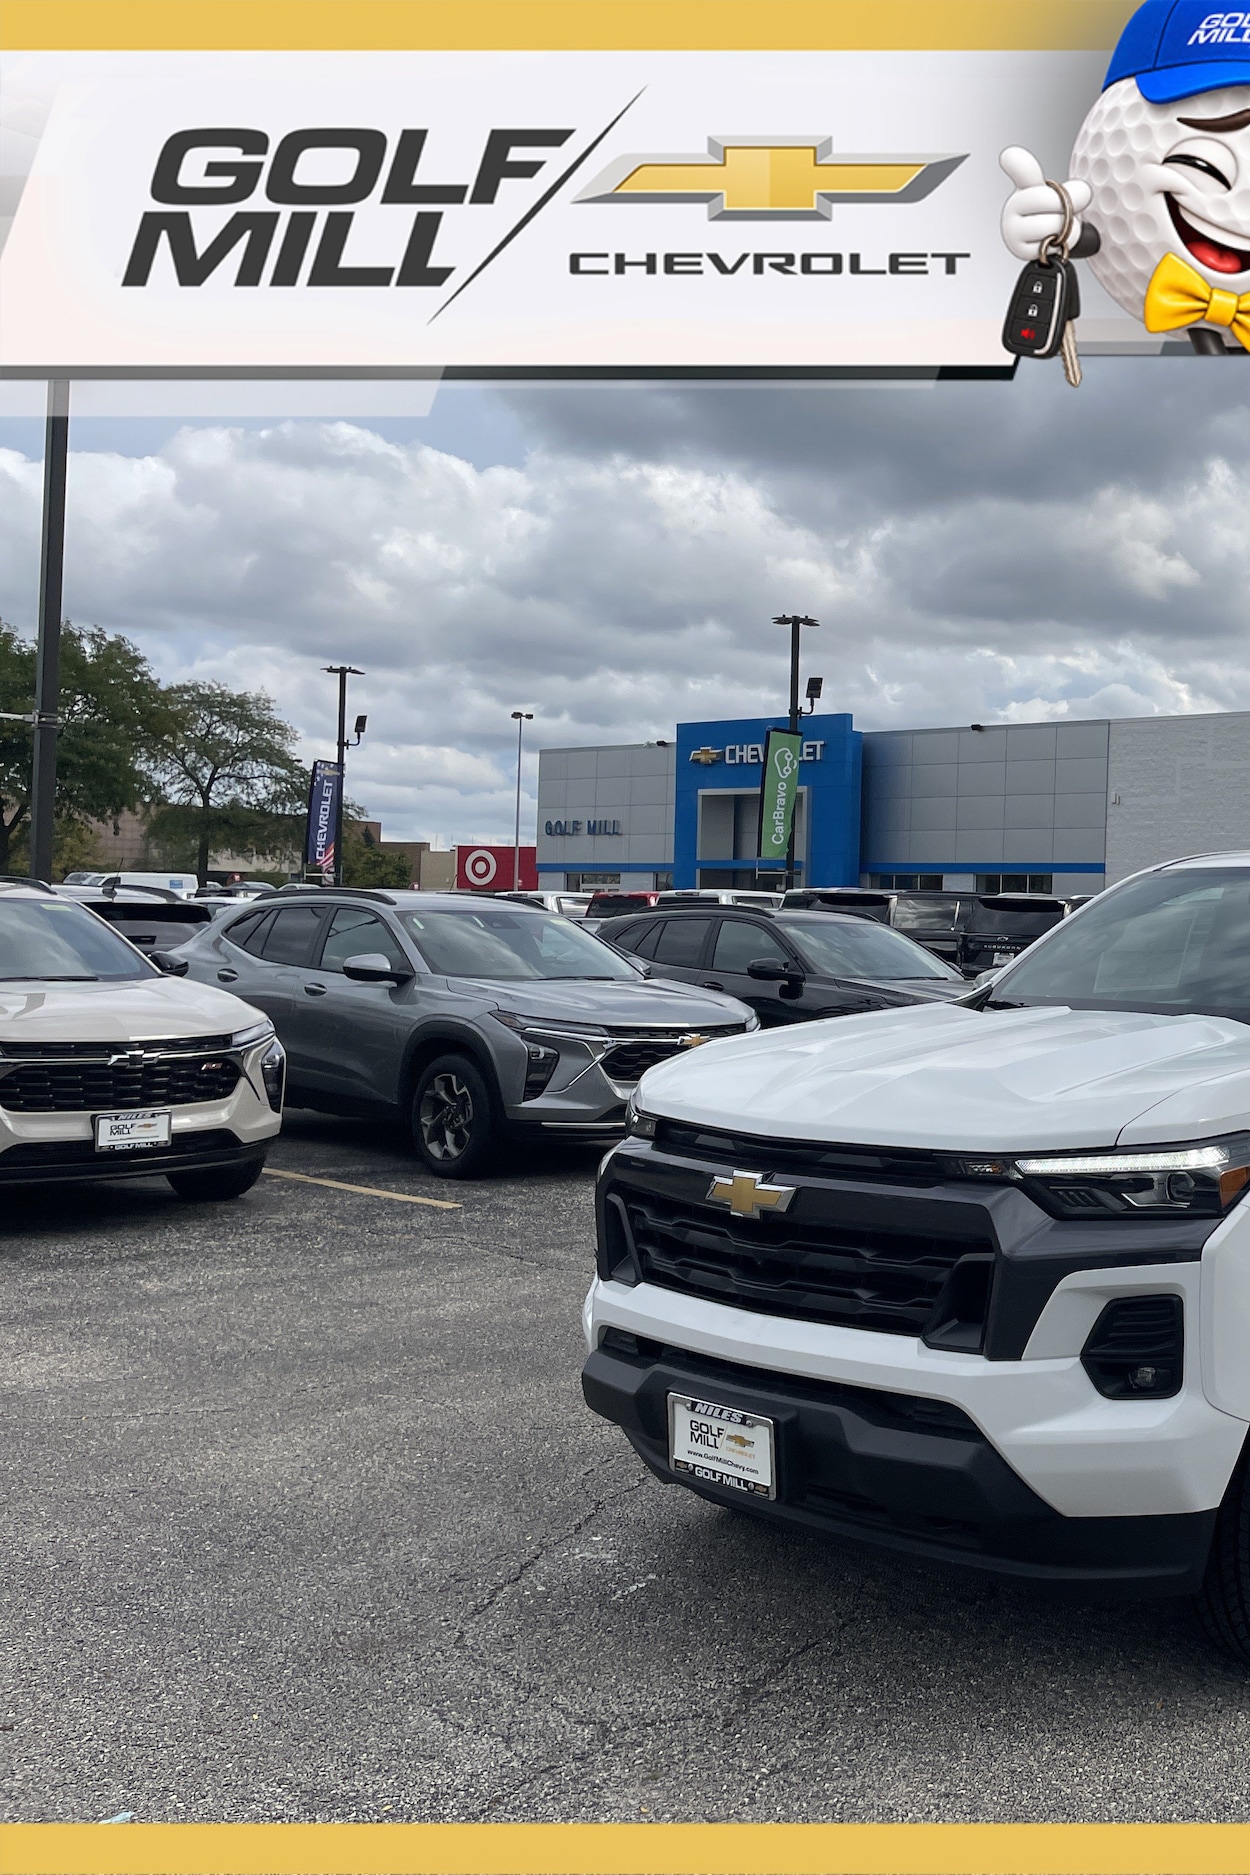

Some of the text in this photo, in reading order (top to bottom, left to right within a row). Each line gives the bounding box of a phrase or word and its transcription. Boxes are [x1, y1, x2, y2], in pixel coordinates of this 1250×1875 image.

[725, 741, 826, 765] CHEVET
[315, 779, 334, 861] CHEVROLET
[771, 781, 787, 845] CarBravo
[545, 820, 622, 836] GOLF MILL
[109, 1128, 132, 1136] MILL
[110, 1123, 136, 1131] GOLF
[694, 1402, 744, 1424] NILES
[689, 1419, 725, 1439] GOLF
[690, 1431, 719, 1450] MILL
[694, 1466, 748, 1492] GOLF MILL
